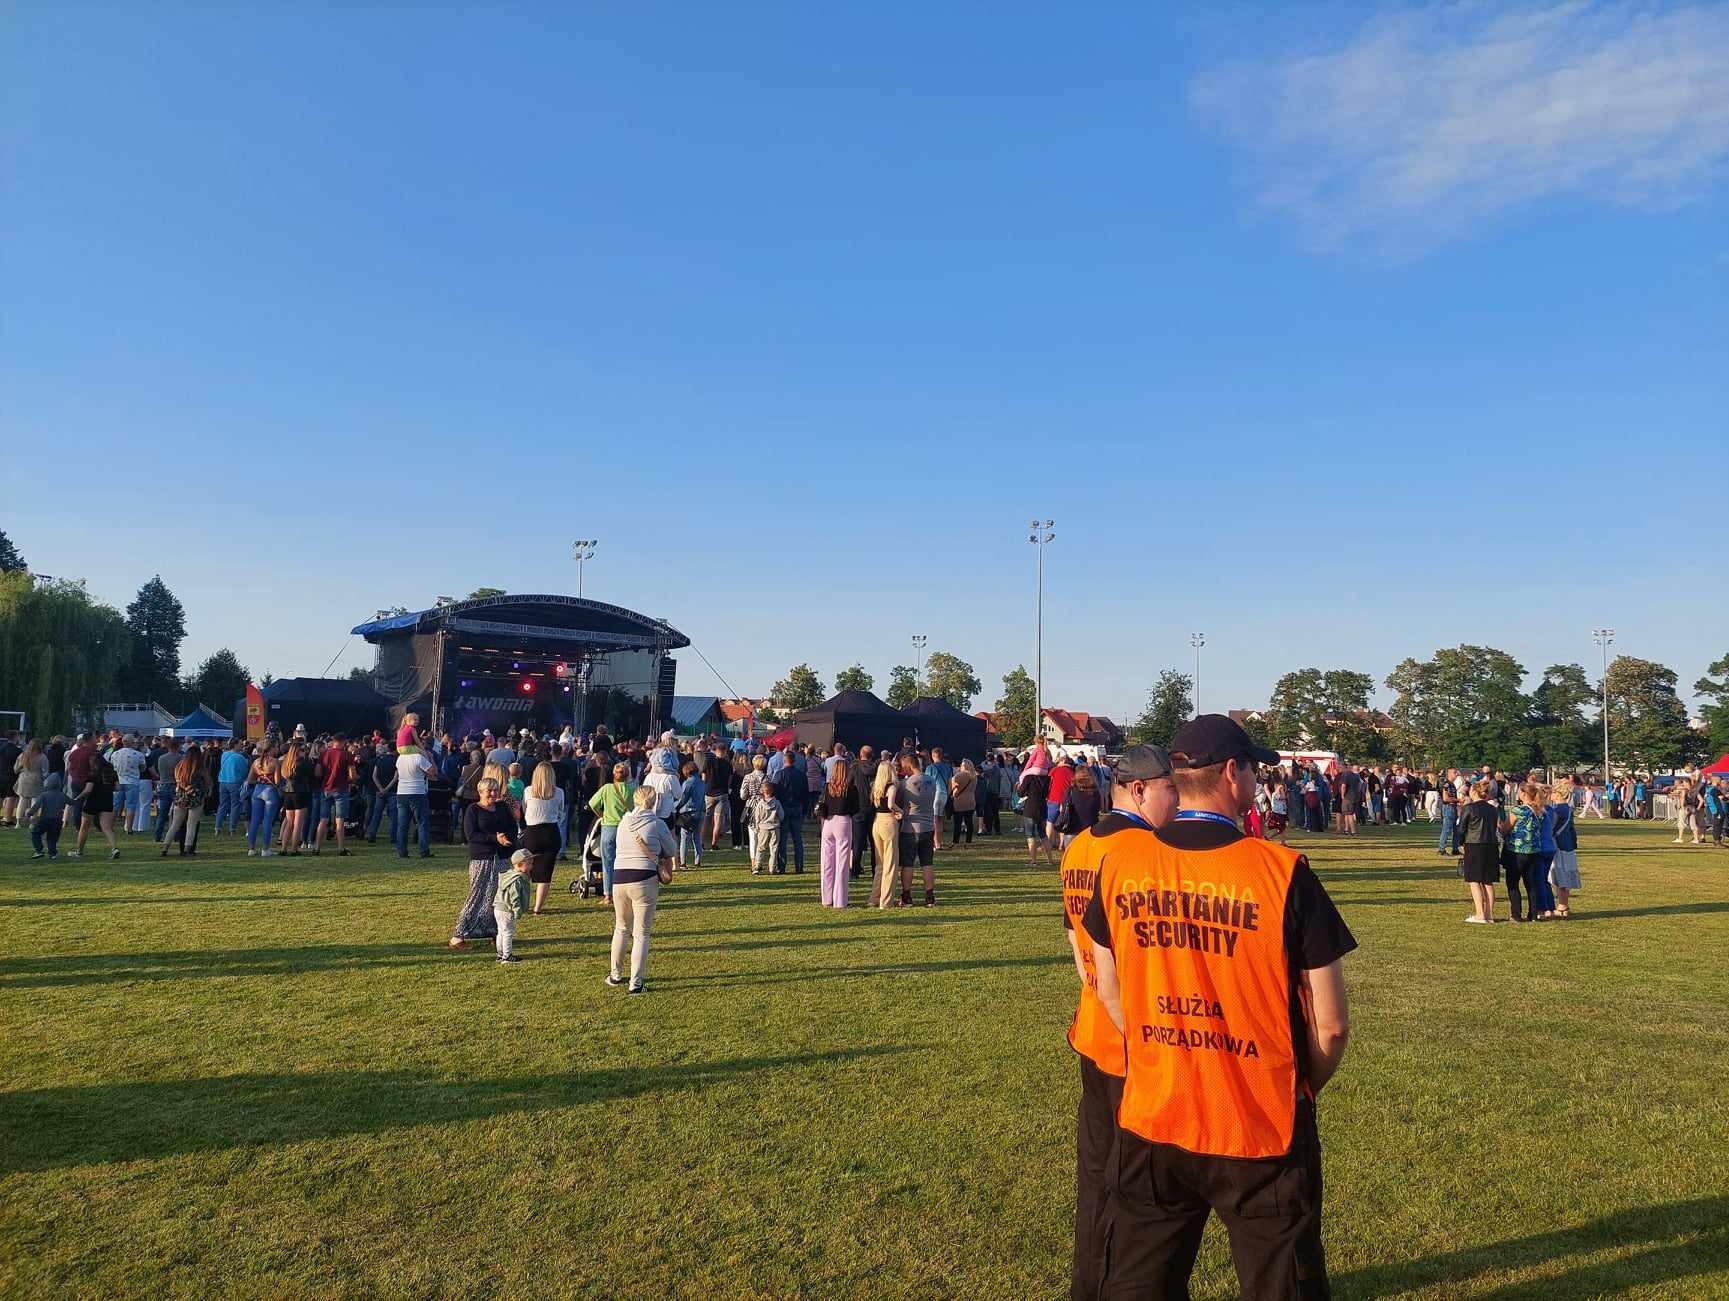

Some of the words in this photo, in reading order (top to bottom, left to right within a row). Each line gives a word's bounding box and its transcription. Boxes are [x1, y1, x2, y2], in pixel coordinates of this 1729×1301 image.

[1115, 889, 1260, 931] SPARTANIE
[1134, 920, 1238, 957] SECURITY
[1141, 1025, 1259, 1058] PORZĄDKOWA
